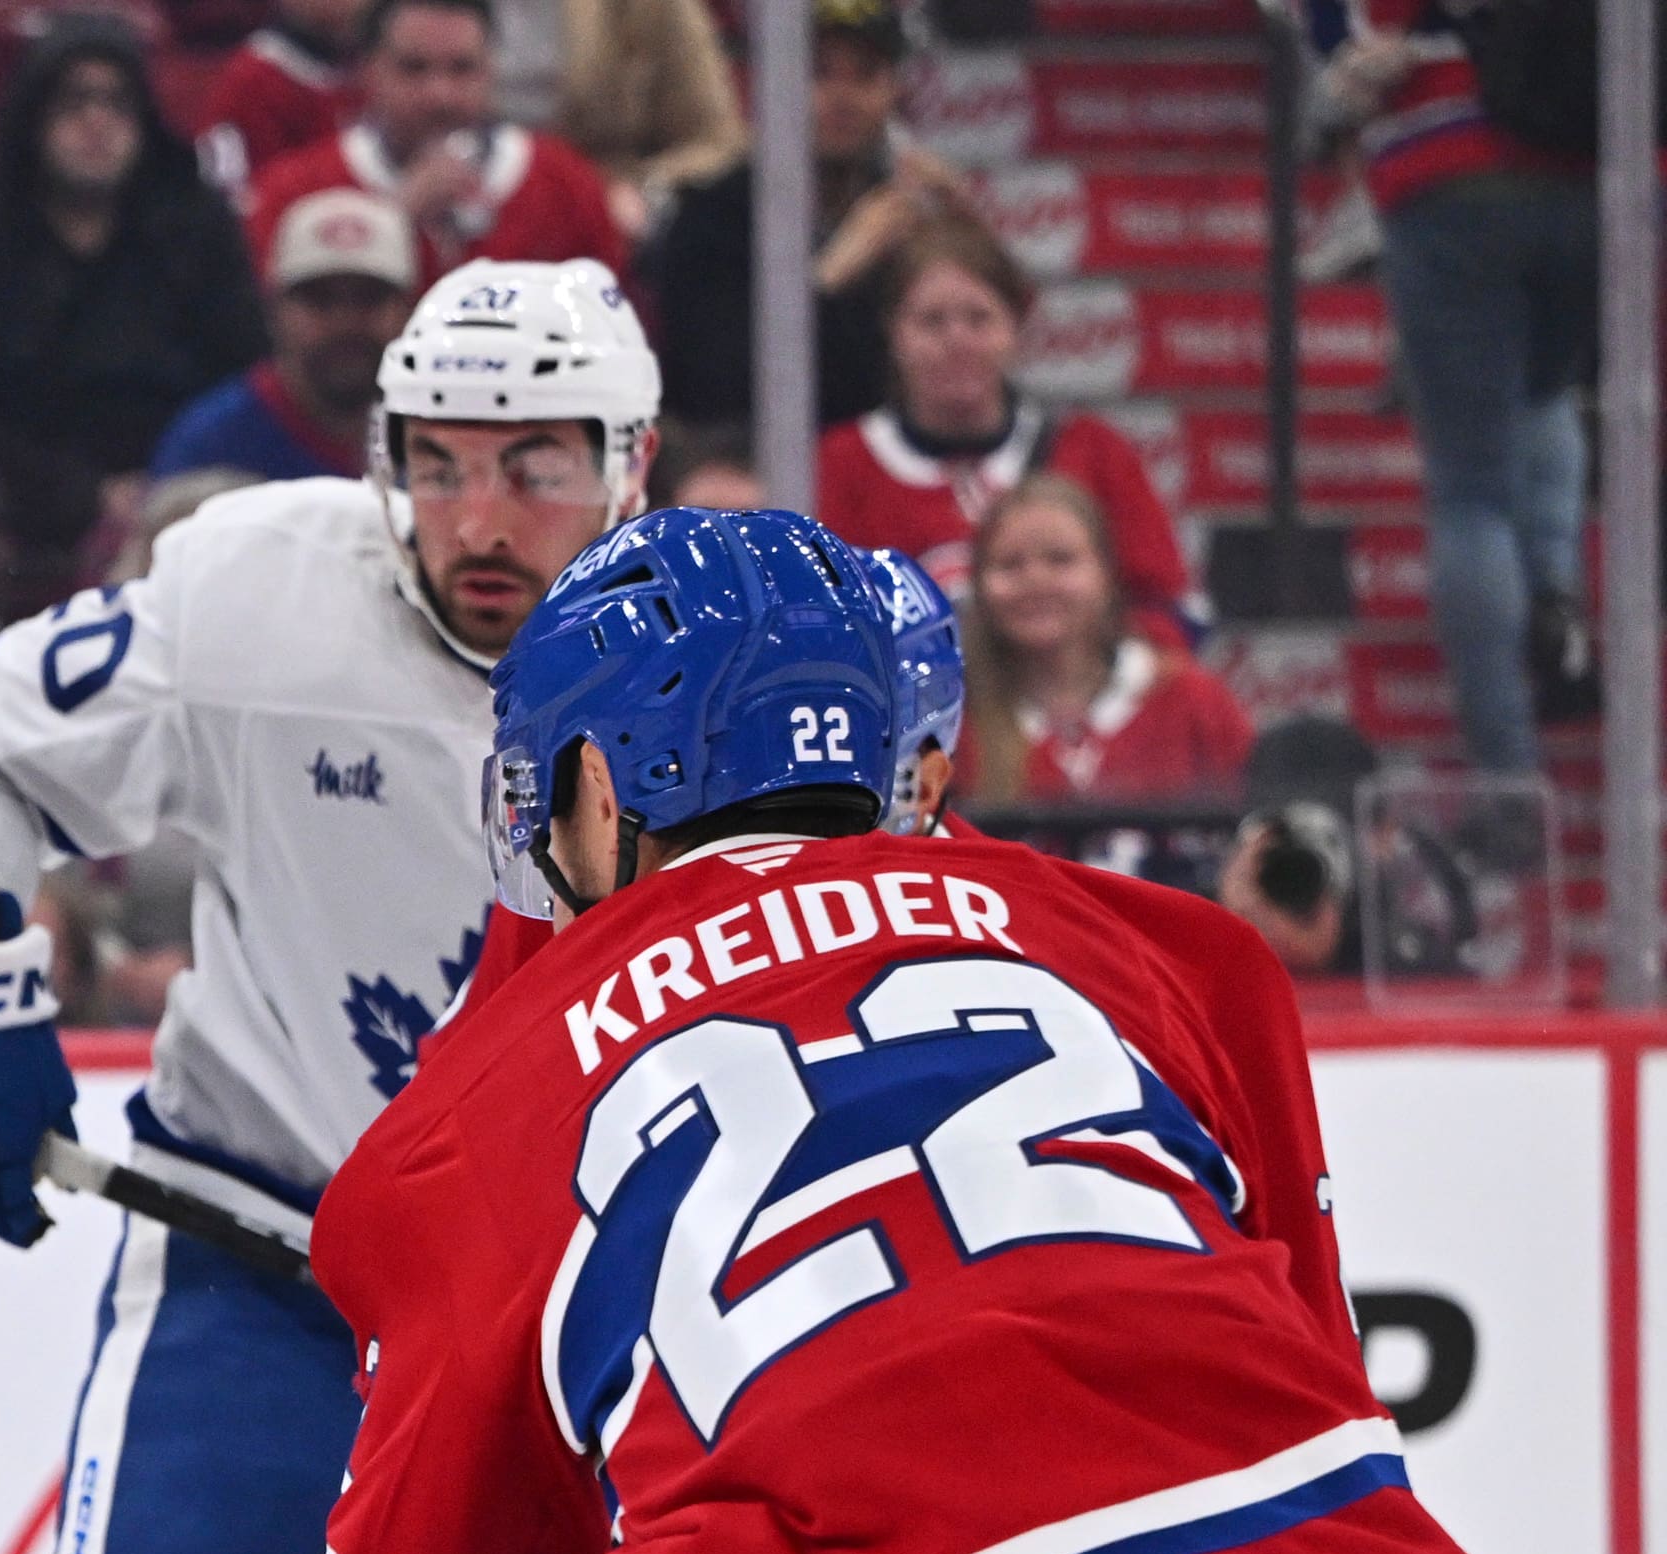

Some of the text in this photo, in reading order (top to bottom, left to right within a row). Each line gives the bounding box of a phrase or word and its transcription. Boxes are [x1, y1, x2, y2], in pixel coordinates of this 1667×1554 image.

[42, 585, 133, 712] 0
[790, 705, 854, 763] 22
[564, 871, 1025, 1076] KREIDER
[571, 953, 1212, 1454] 22
